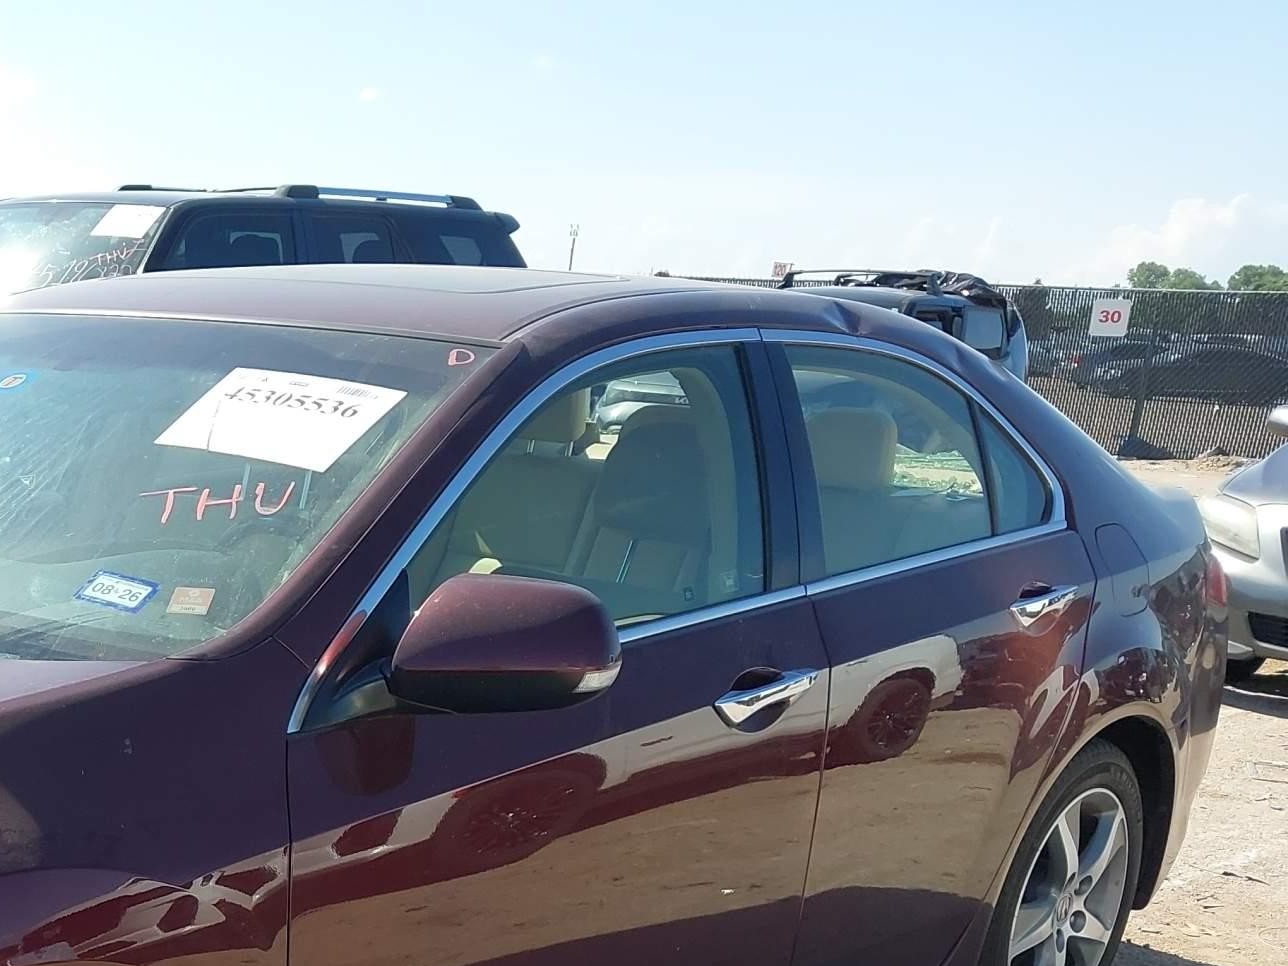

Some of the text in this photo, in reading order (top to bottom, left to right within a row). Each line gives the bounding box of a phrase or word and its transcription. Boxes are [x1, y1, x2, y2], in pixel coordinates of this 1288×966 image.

[1098, 309, 1122, 324] 30
[447, 348, 476, 367] D
[224, 385, 361, 419] 45305536
[139, 480, 297, 525] THU
[91, 582, 114, 595] 08
[117, 588, 143, 603] 26
